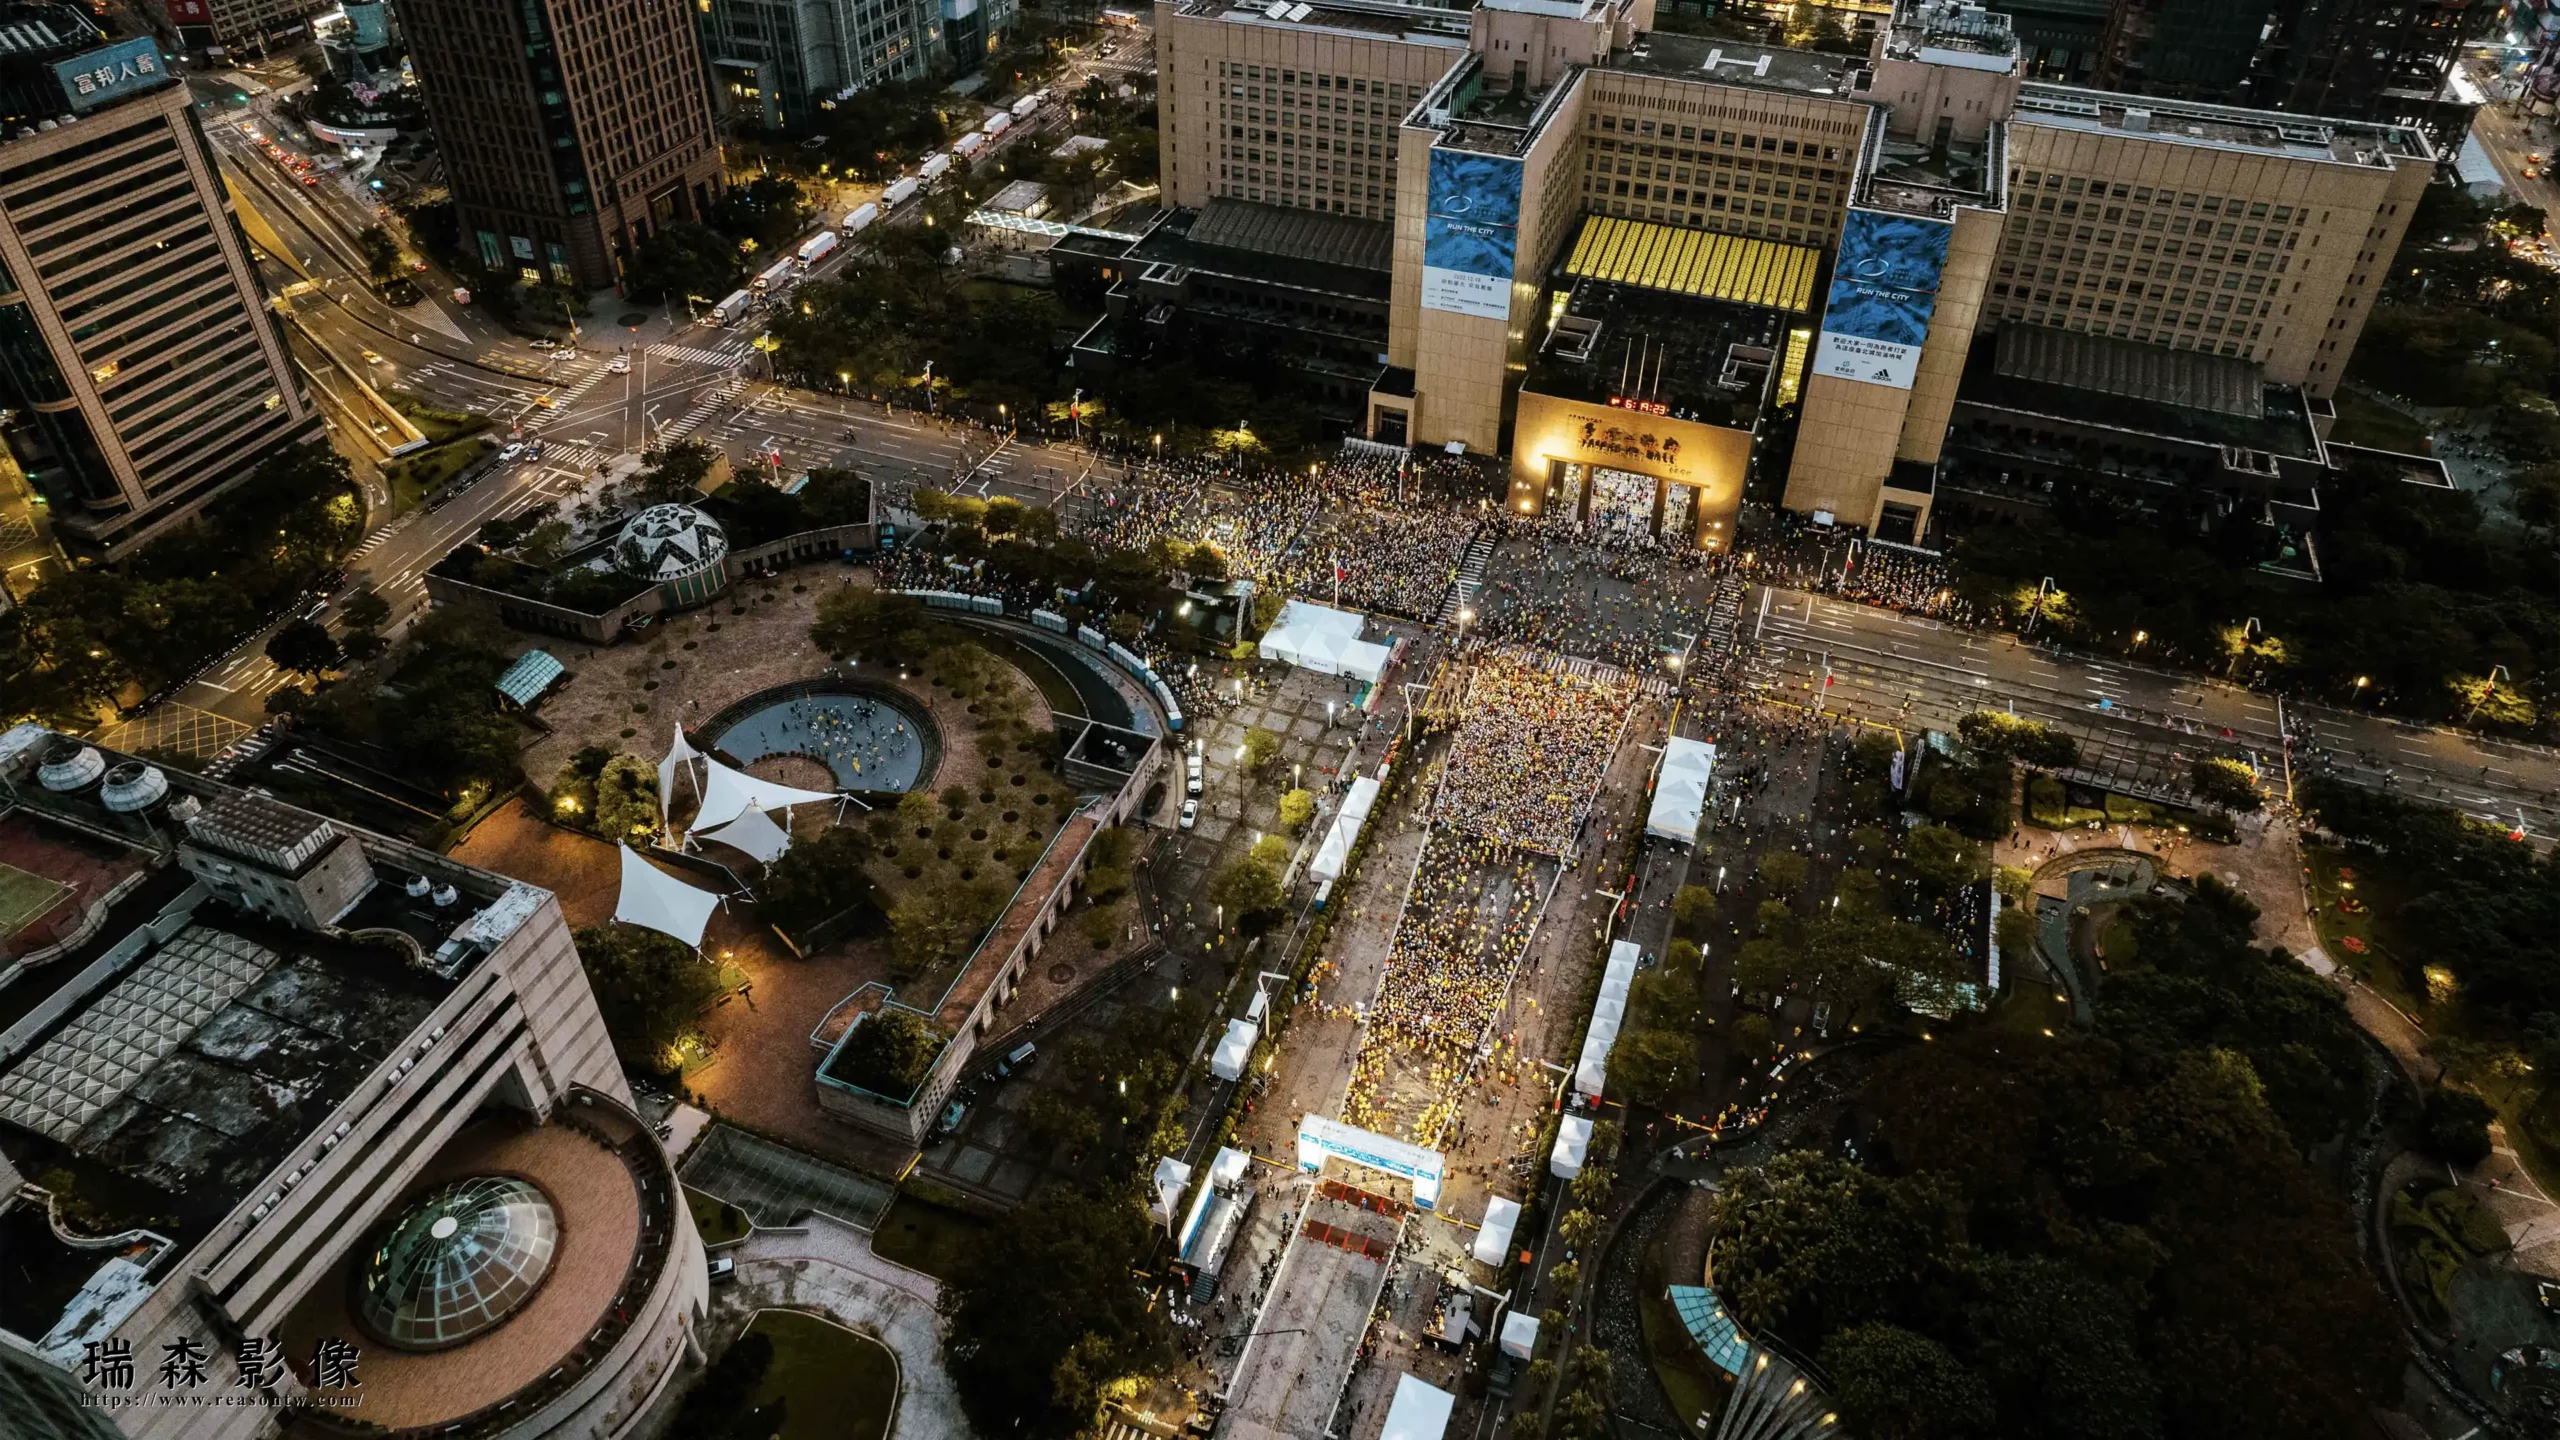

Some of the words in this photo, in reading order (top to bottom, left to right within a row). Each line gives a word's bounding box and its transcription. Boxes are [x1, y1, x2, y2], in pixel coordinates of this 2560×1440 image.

[73, 52, 155, 95] 富邦人壽
[1447, 223, 1463, 231] RUN
[1463, 225, 1478, 233] THE
[1478, 227, 1495, 236] CITY
[1856, 287, 1874, 296] RUN
[1875, 290, 1891, 298] THE
[1891, 293, 1910, 301] CITY
